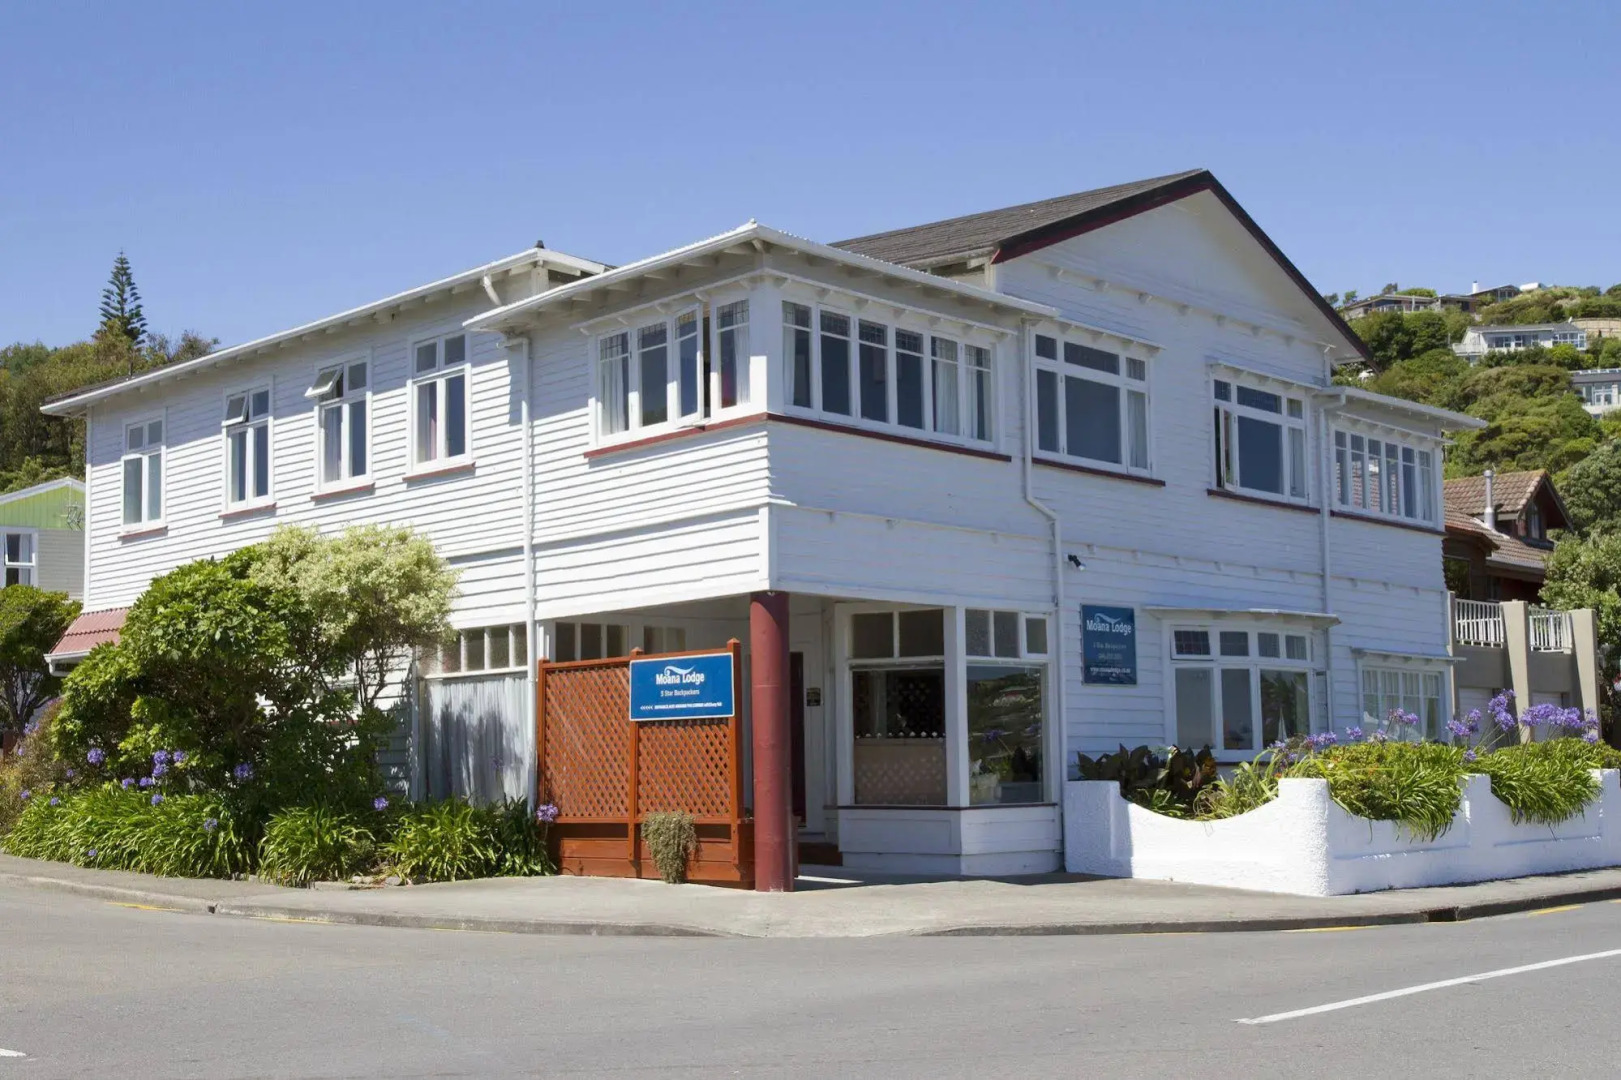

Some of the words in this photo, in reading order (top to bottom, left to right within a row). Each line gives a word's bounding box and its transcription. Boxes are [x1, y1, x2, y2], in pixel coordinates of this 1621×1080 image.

[1086, 620, 1110, 632] Moana
[1112, 622, 1132, 636] Lodge
[656, 673, 680, 685] Moana
[682, 671, 705, 685] Lodge
[674, 689, 700, 697] Backpackers
